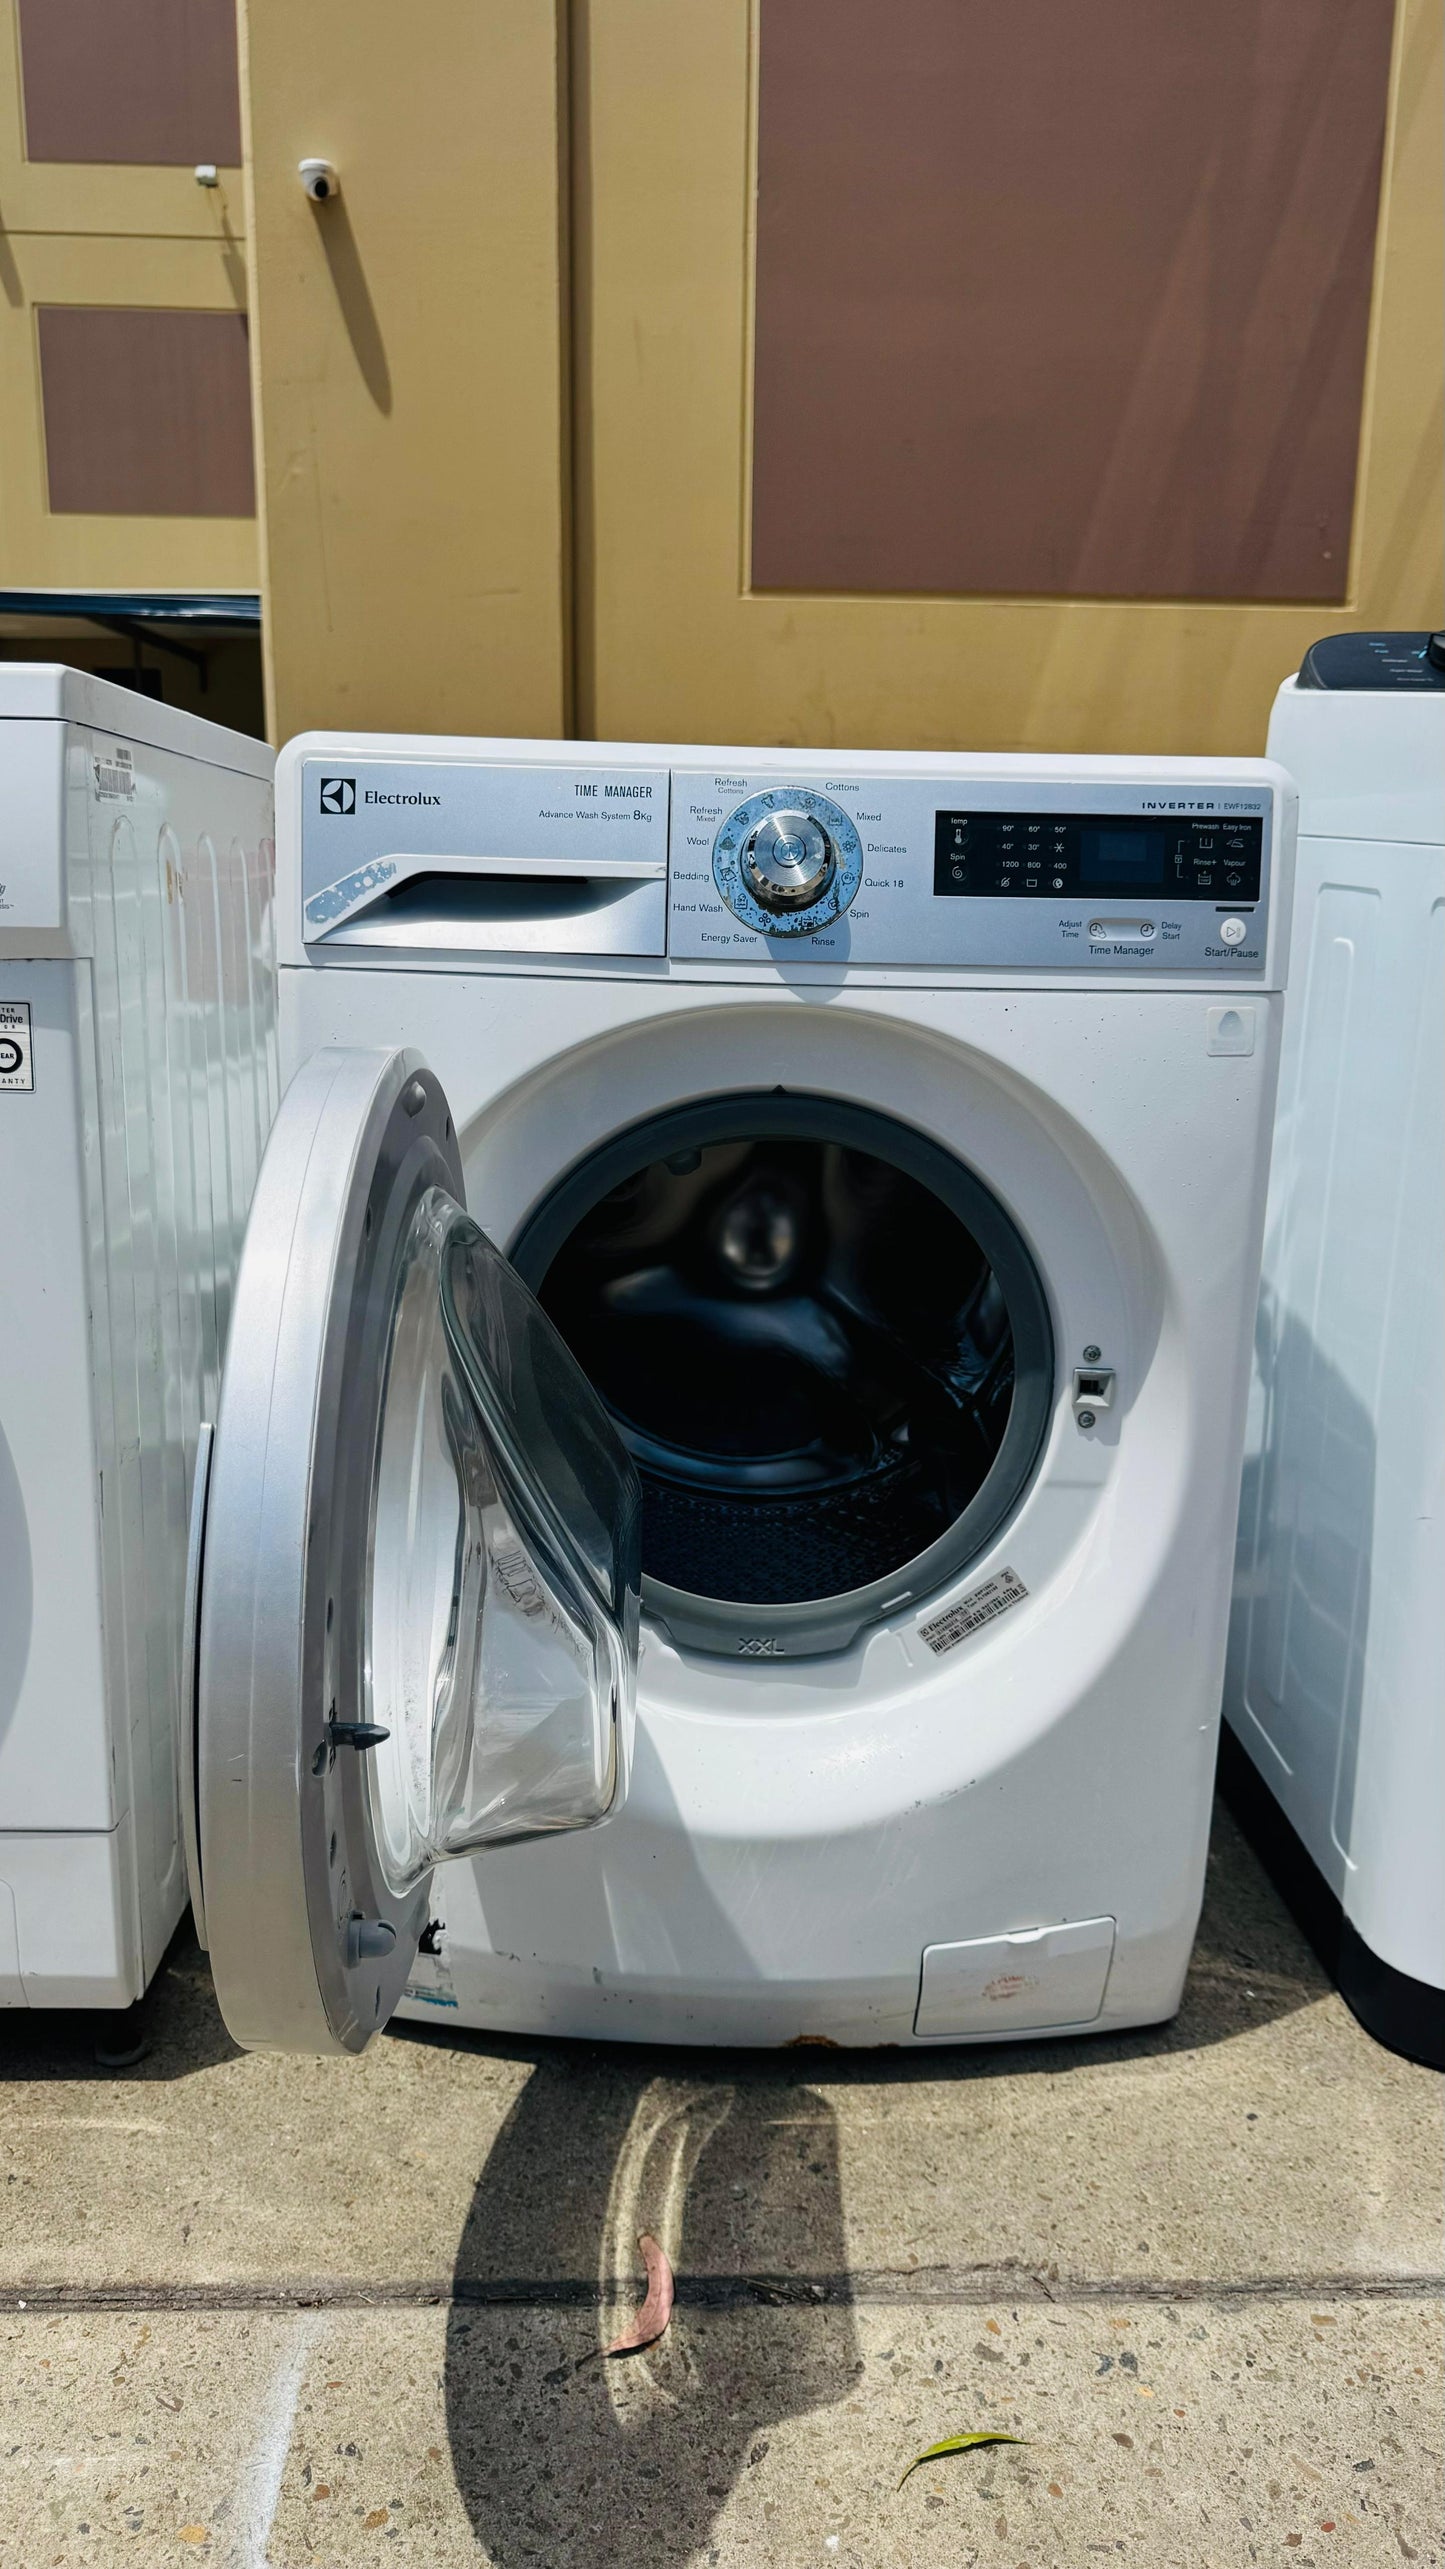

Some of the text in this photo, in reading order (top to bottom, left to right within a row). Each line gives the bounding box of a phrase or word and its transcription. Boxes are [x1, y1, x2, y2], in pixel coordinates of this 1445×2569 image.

[714, 778, 748, 787] Refresh
[825, 782, 860, 791] Cottons
[574, 784, 653, 798] TIME MANAGER
[364, 790, 441, 806] Electrolux
[689, 806, 723, 815] Refresh
[1142, 802, 1214, 810] INVERTER
[538, 809, 652, 822] Advance Wash System 8Kg
[856, 812, 882, 821] Mixed
[951, 817, 968, 825] Temp
[1222, 823, 1252, 832] Easy Iron
[686, 837, 710, 846] Wool
[867, 843, 907, 854] Delicates
[950, 853, 966, 861] Spin
[1027, 861, 1041, 869] 800
[1223, 859, 1246, 867] Vapour
[673, 871, 710, 882] Bedding
[864, 878, 904, 888] Quick 18
[673, 903, 724, 913] Hand Wash
[849, 909, 870, 918] Spin
[1058, 919, 1082, 930] Adjust
[1161, 921, 1182, 931] Delay
[701, 932, 758, 944] Energy Saver
[1061, 930, 1079, 939] Time
[1161, 931, 1181, 940] Start
[811, 936, 836, 946] Rinse
[1088, 945, 1155, 957] Time Manager
[1204, 946, 1259, 959] Start/Pause
[928, 1606, 964, 1632] Electrolux
[738, 1637, 785, 1655] XXL
